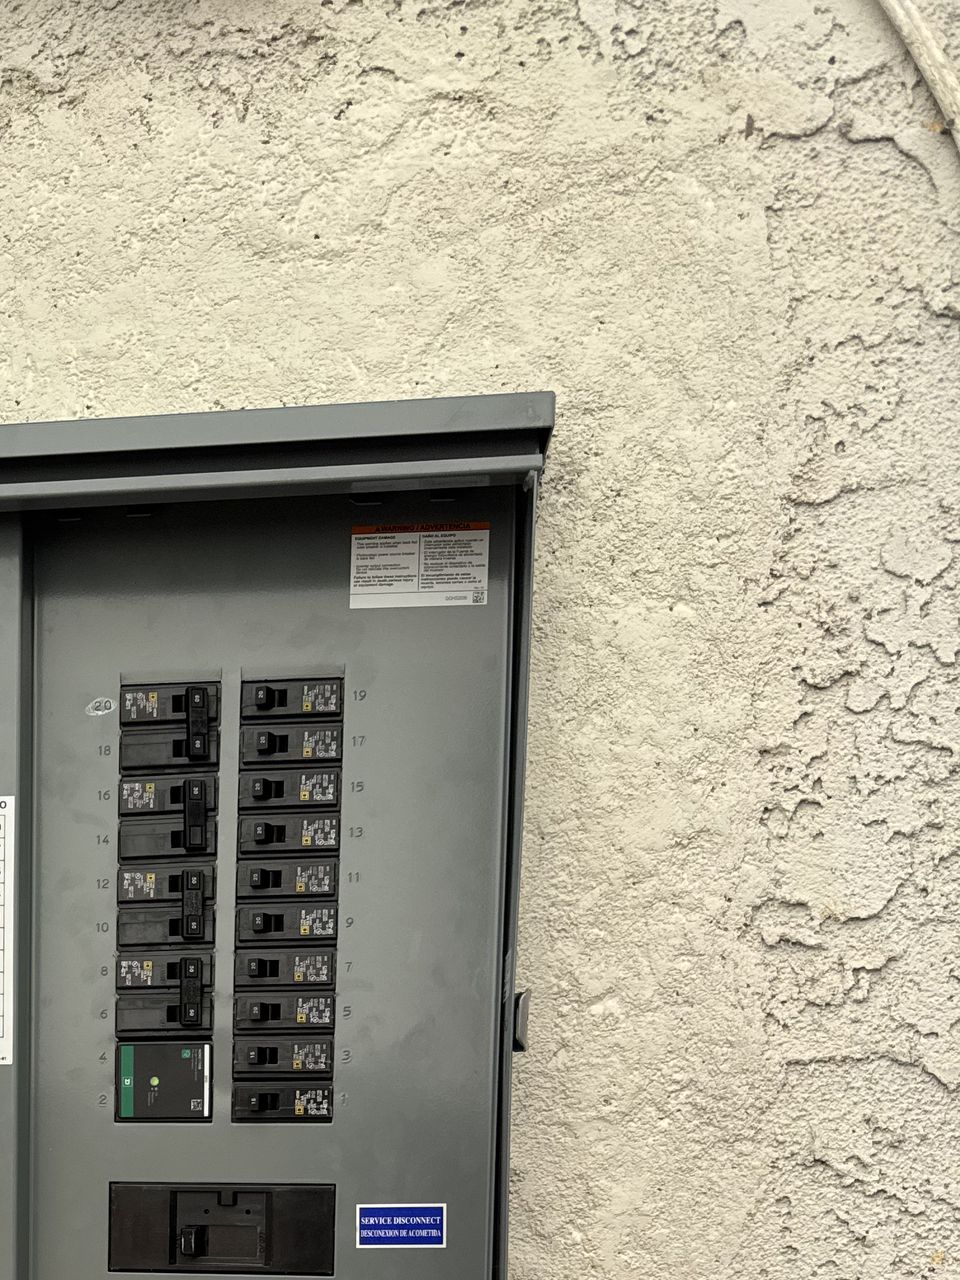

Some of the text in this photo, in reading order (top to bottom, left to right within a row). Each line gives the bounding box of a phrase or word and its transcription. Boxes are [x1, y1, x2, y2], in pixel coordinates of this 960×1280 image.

[352, 690, 366, 701] 19
[94, 700, 112, 711] 20
[351, 736, 365, 747] 17
[98, 745, 111, 756] 18
[350, 781, 364, 792] 15
[97, 790, 111, 800] 16
[348, 826, 363, 838] 13
[96, 835, 110, 845] 14
[347, 872, 360, 883] 11
[96, 878, 109, 889] 12
[95, 922, 109, 933] 10
[345, 917, 354, 928] 9
[100, 966, 108, 976] 8
[345, 961, 352, 973] 7
[100, 1009, 108, 1019] 6
[342, 1006, 352, 1018] 5
[98, 1052, 107, 1061] 4
[341, 1050, 351, 1061] 3
[98, 1094, 107, 1105] 2
[360, 1216, 441, 1225] SERVICE DISCONNECT
[360, 1229, 442, 1237] DESCONEXION DE ACOMETIDA
